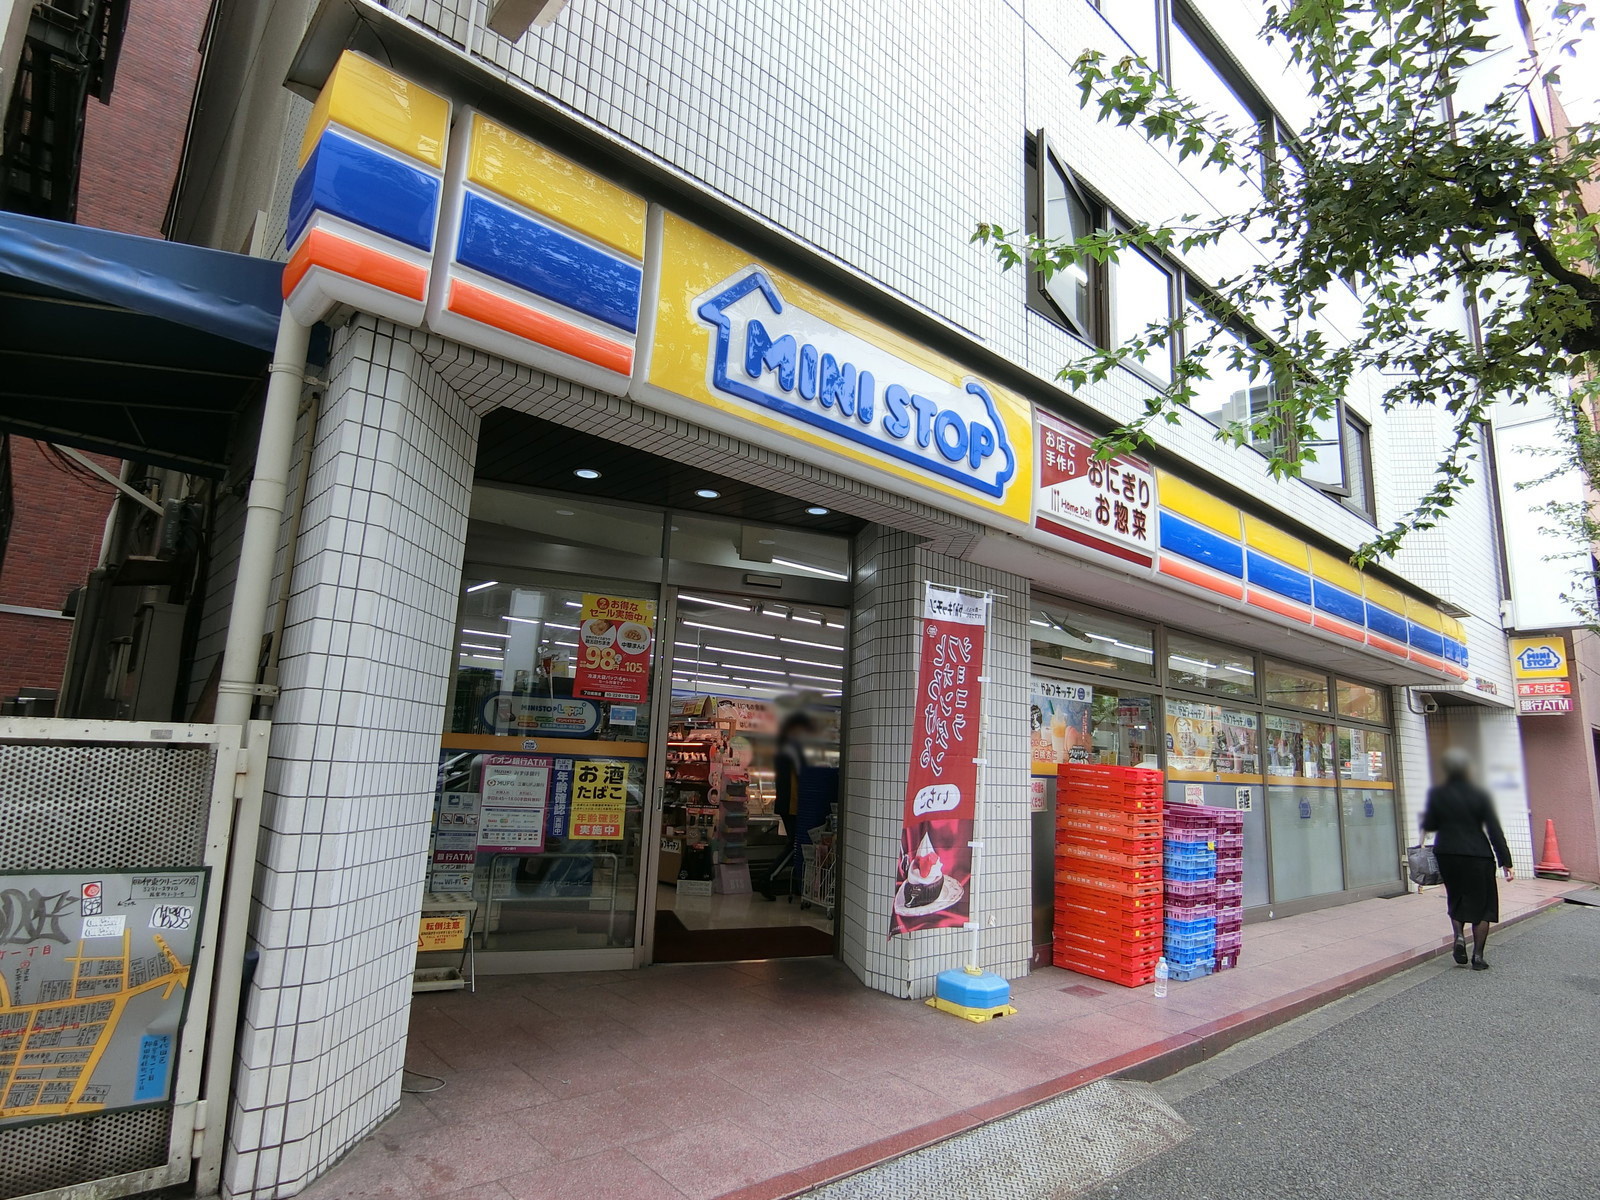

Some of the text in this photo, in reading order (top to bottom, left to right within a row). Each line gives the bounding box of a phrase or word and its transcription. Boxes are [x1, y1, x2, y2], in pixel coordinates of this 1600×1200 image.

[744, 319, 995, 470] MINI STOP
[1045, 431, 1076, 458] お店で
[1045, 450, 1076, 476] 手作り
[1087, 454, 1151, 509] おにぎり
[1061, 498, 1079, 513] Home
[1080, 506, 1092, 520] Deli
[1095, 493, 1147, 542] お惣菜
[610, 600, 639, 612] お得な
[1526, 659, 1552, 667] STOP
[1040, 682, 1077, 699] やみつキッチン
[1518, 684, 1566, 694] 酒・たばこ
[1520, 699, 1570, 712] 銀行ATM
[489, 756, 547, 766] イオン銀行ATM
[578, 765, 626, 785] お酒
[553, 771, 569, 816] 年齢確認
[576, 785, 623, 800] たばこ
[576, 813, 620, 824] 年齢確認
[579, 825, 615, 835] 実施中
[437, 853, 473, 863] 銀行ATM
[444, 878, 462, 886] Wi-Fi
[425, 920, 460, 931] 転倒注意
